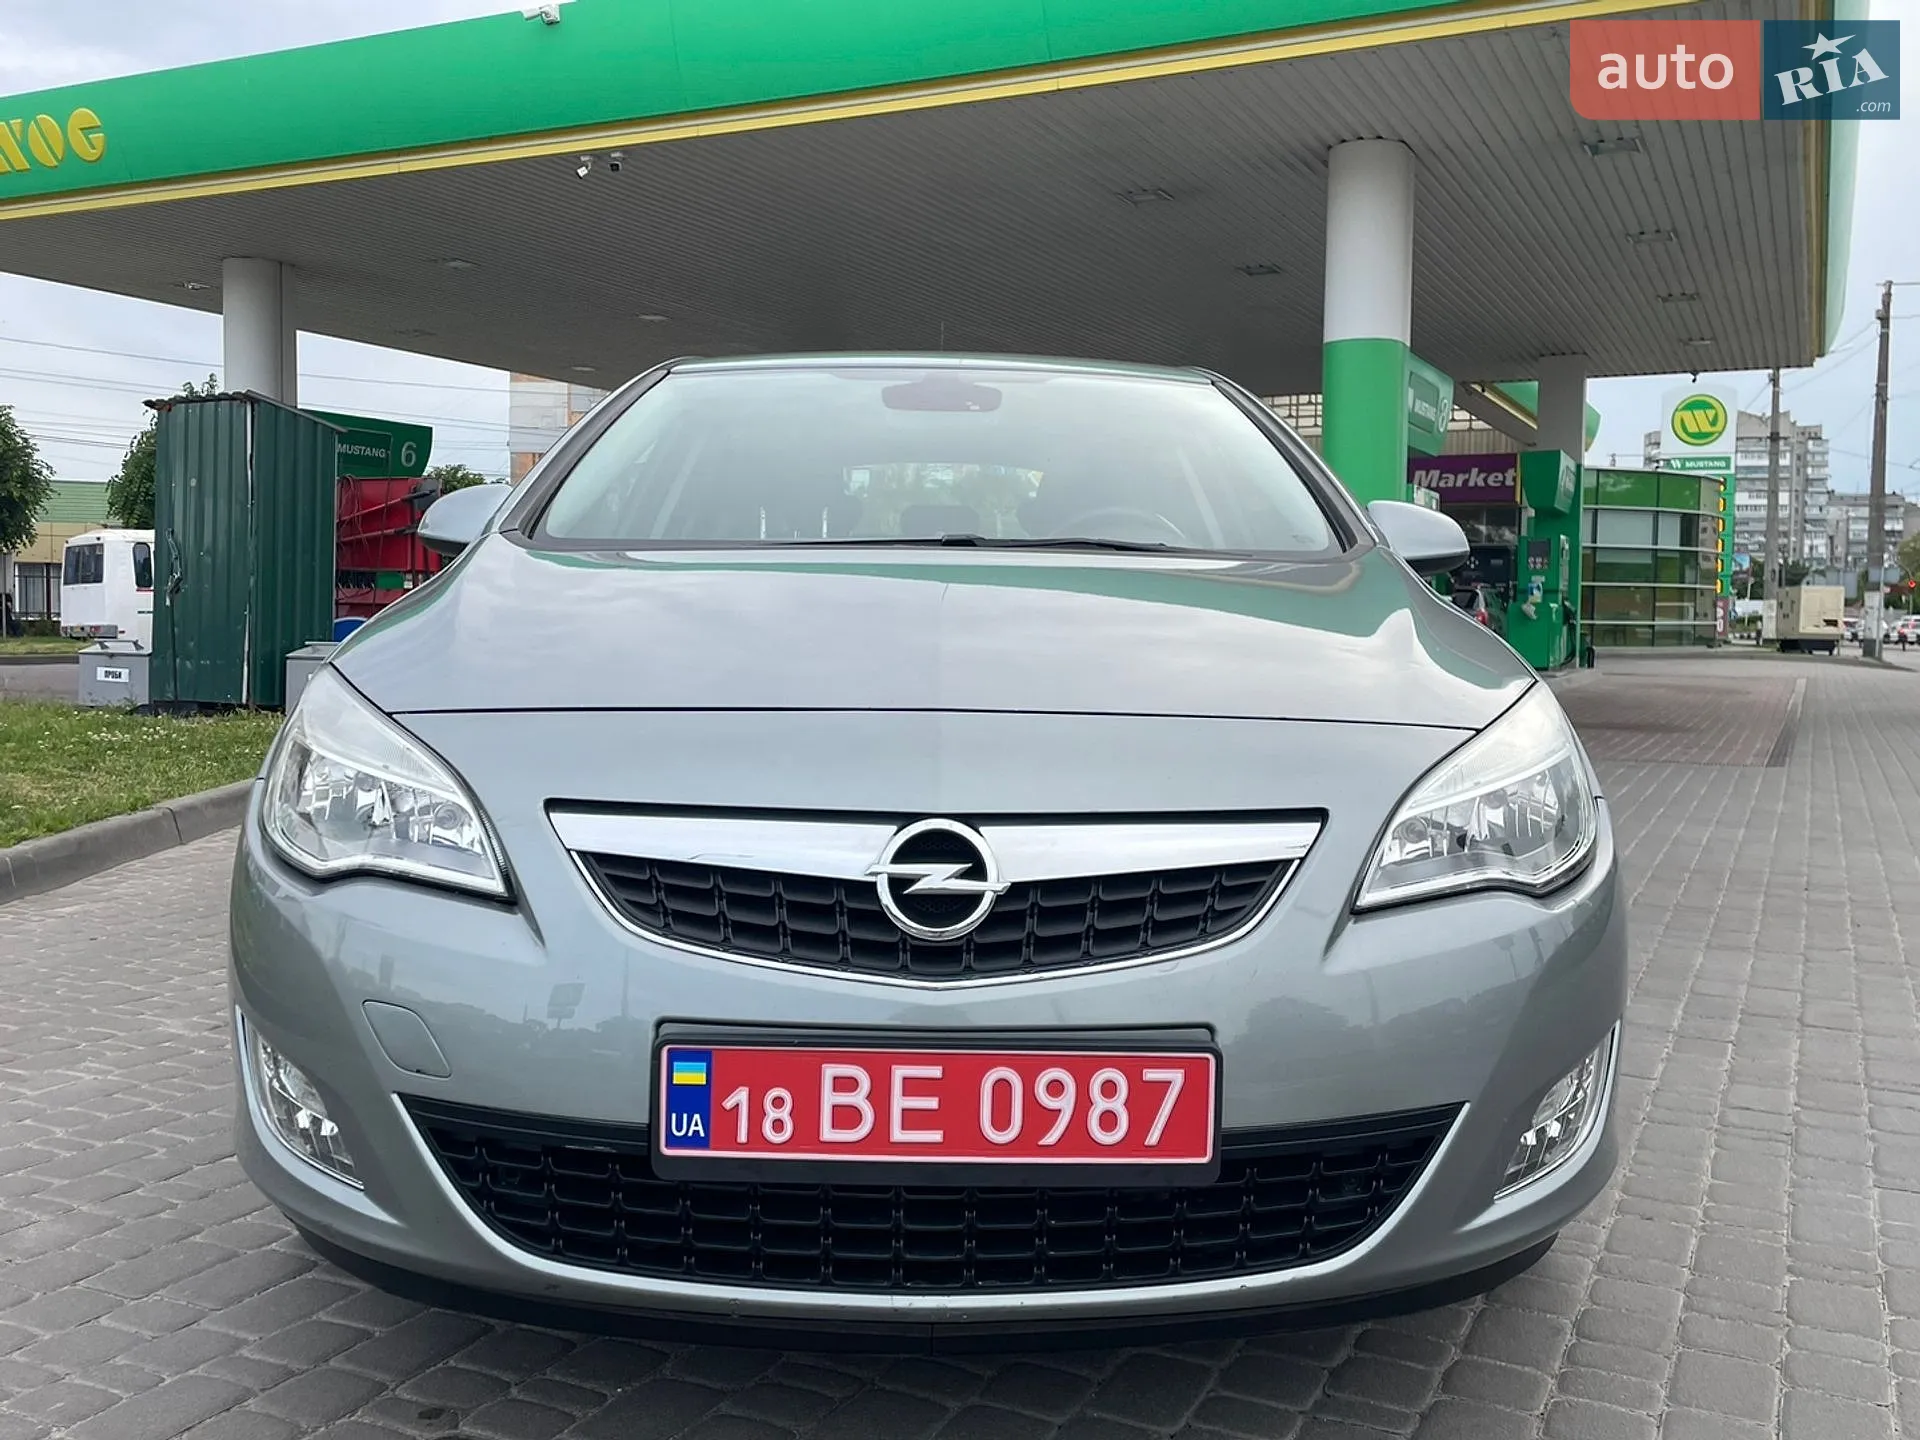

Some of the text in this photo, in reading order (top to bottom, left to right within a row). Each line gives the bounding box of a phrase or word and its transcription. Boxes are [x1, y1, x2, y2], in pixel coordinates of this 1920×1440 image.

[337, 443, 386, 458] MUSTANG
[400, 441, 417, 467] 6
[1685, 460, 1726, 469] MUSTANG
[1414, 468, 1516, 488] Market
[721, 1063, 1186, 1147] 18 BE 0987
[671, 1113, 705, 1138] UA
